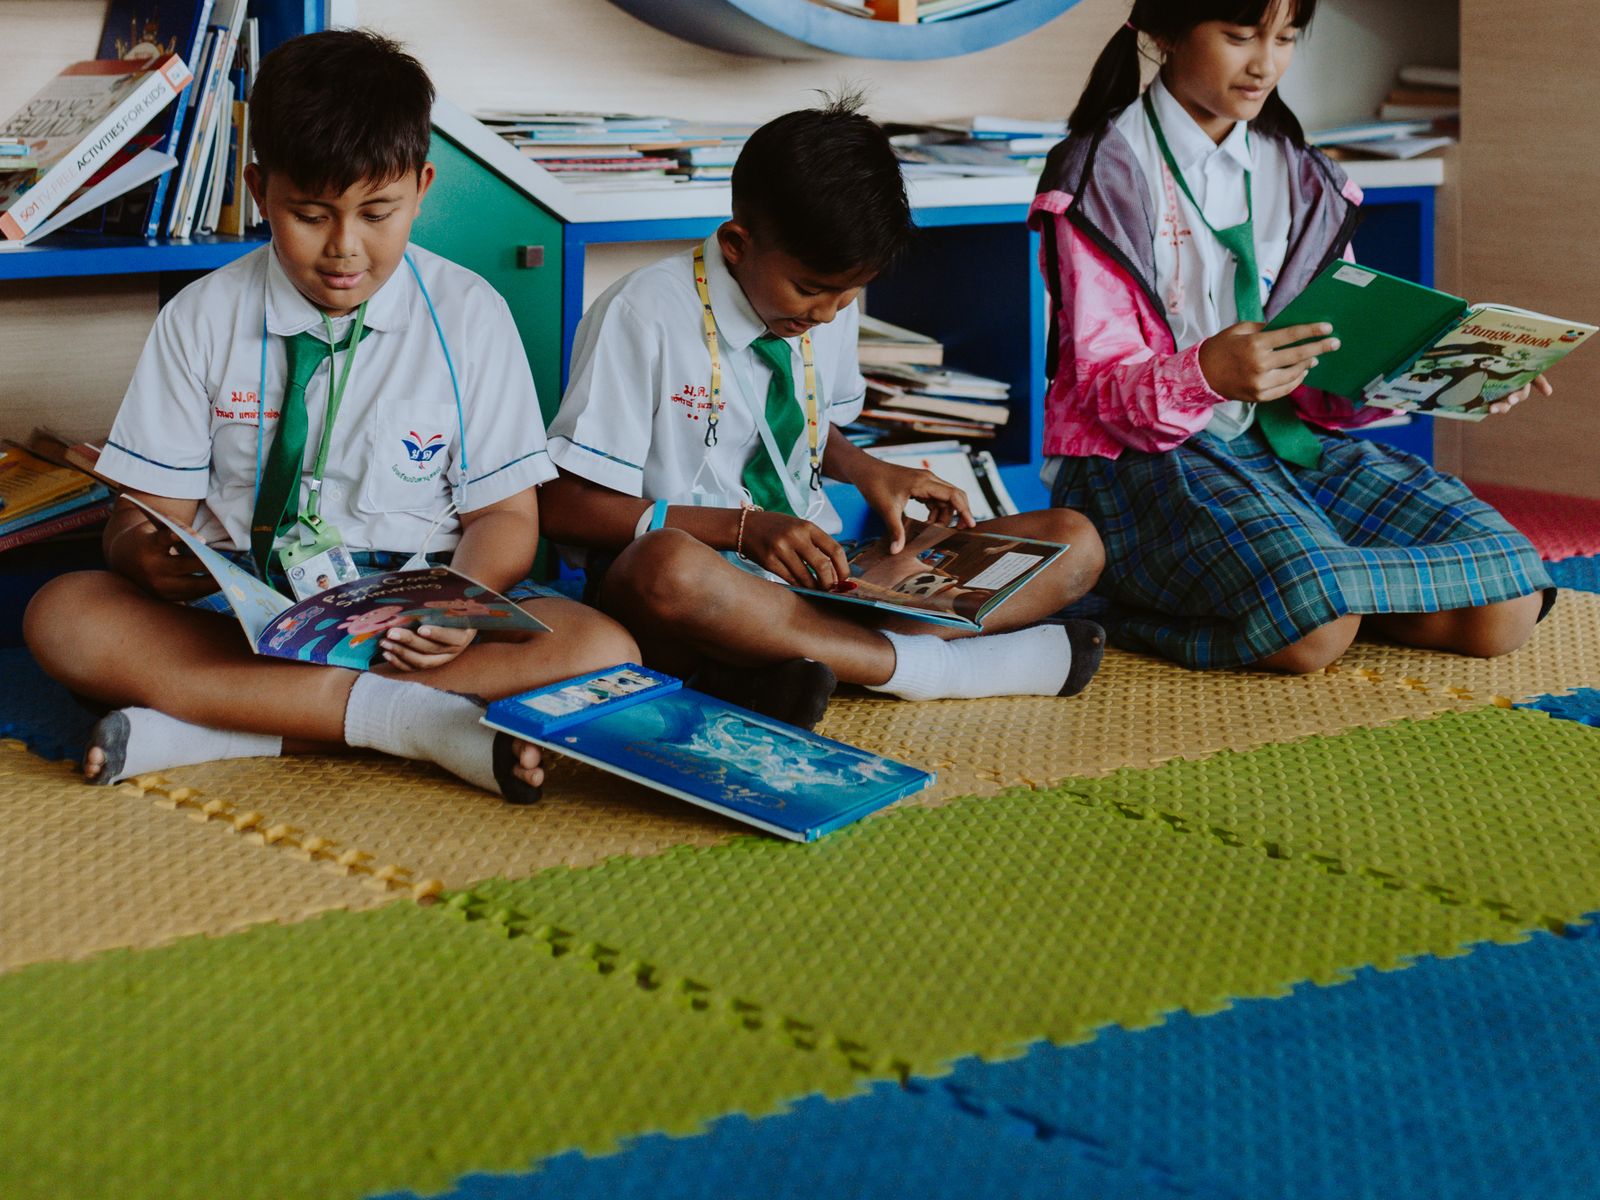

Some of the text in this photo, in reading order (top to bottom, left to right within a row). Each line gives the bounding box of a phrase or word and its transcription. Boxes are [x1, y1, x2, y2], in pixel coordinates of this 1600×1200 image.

[20, 83, 167, 222] 501 TV-FREE ACTIVITIES FOR KIDS
[1461, 324, 1514, 341] Jungle
[1514, 333, 1555, 349] Book
